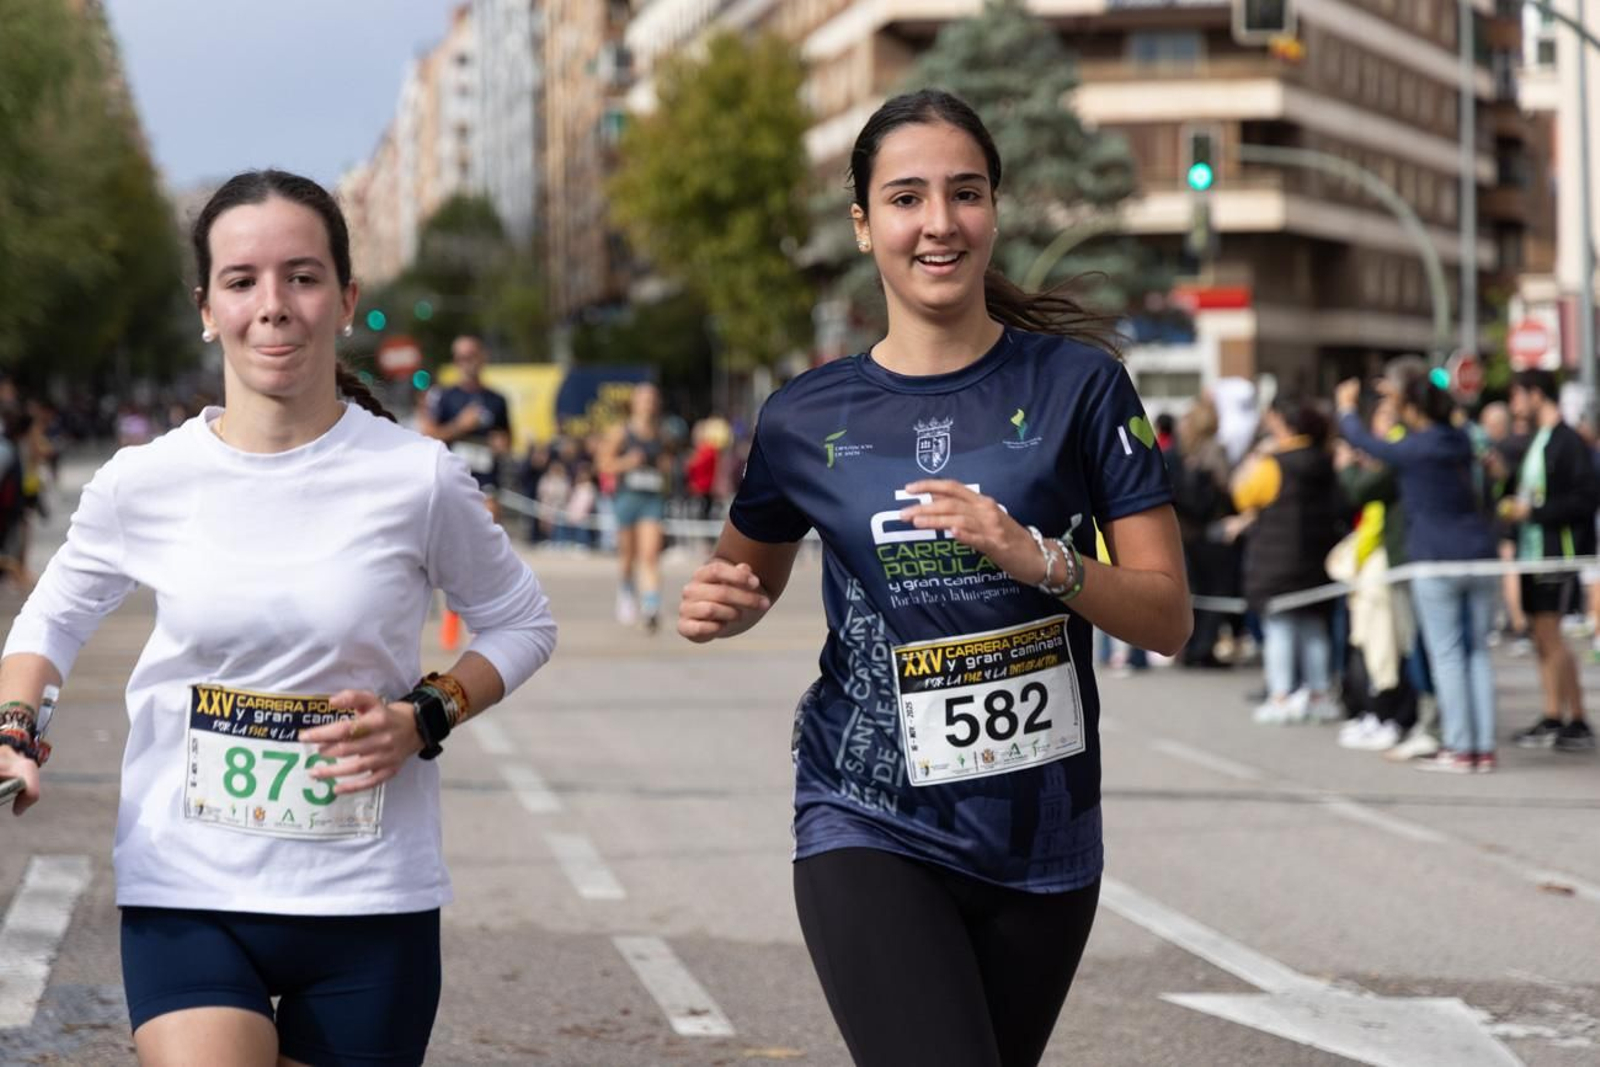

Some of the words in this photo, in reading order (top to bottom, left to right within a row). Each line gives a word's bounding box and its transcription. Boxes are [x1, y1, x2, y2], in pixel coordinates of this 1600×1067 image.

[876, 540, 977, 562] CARRE
[883, 555, 997, 579] POPULA
[888, 582, 900, 593] y
[903, 577, 940, 592] gran
[903, 648, 943, 677] XXV
[944, 639, 1010, 660] CARRERA
[1012, 623, 1063, 648] POPULAR
[946, 659, 956, 672] y
[965, 652, 1003, 670] gran
[1010, 634, 1064, 659] caminata
[924, 675, 945, 689] POR
[946, 673, 962, 687] LA
[992, 665, 1008, 679] LA
[196, 687, 235, 718] XXV
[236, 695, 304, 714] CARRERA
[235, 708, 246, 721] y
[253, 711, 294, 724] gran
[944, 681, 1053, 748] 582
[212, 719, 231, 732] POR
[232, 722, 248, 736] LA
[278, 728, 296, 741] LA
[223, 746, 338, 806] 873
[872, 747, 898, 784] DE
